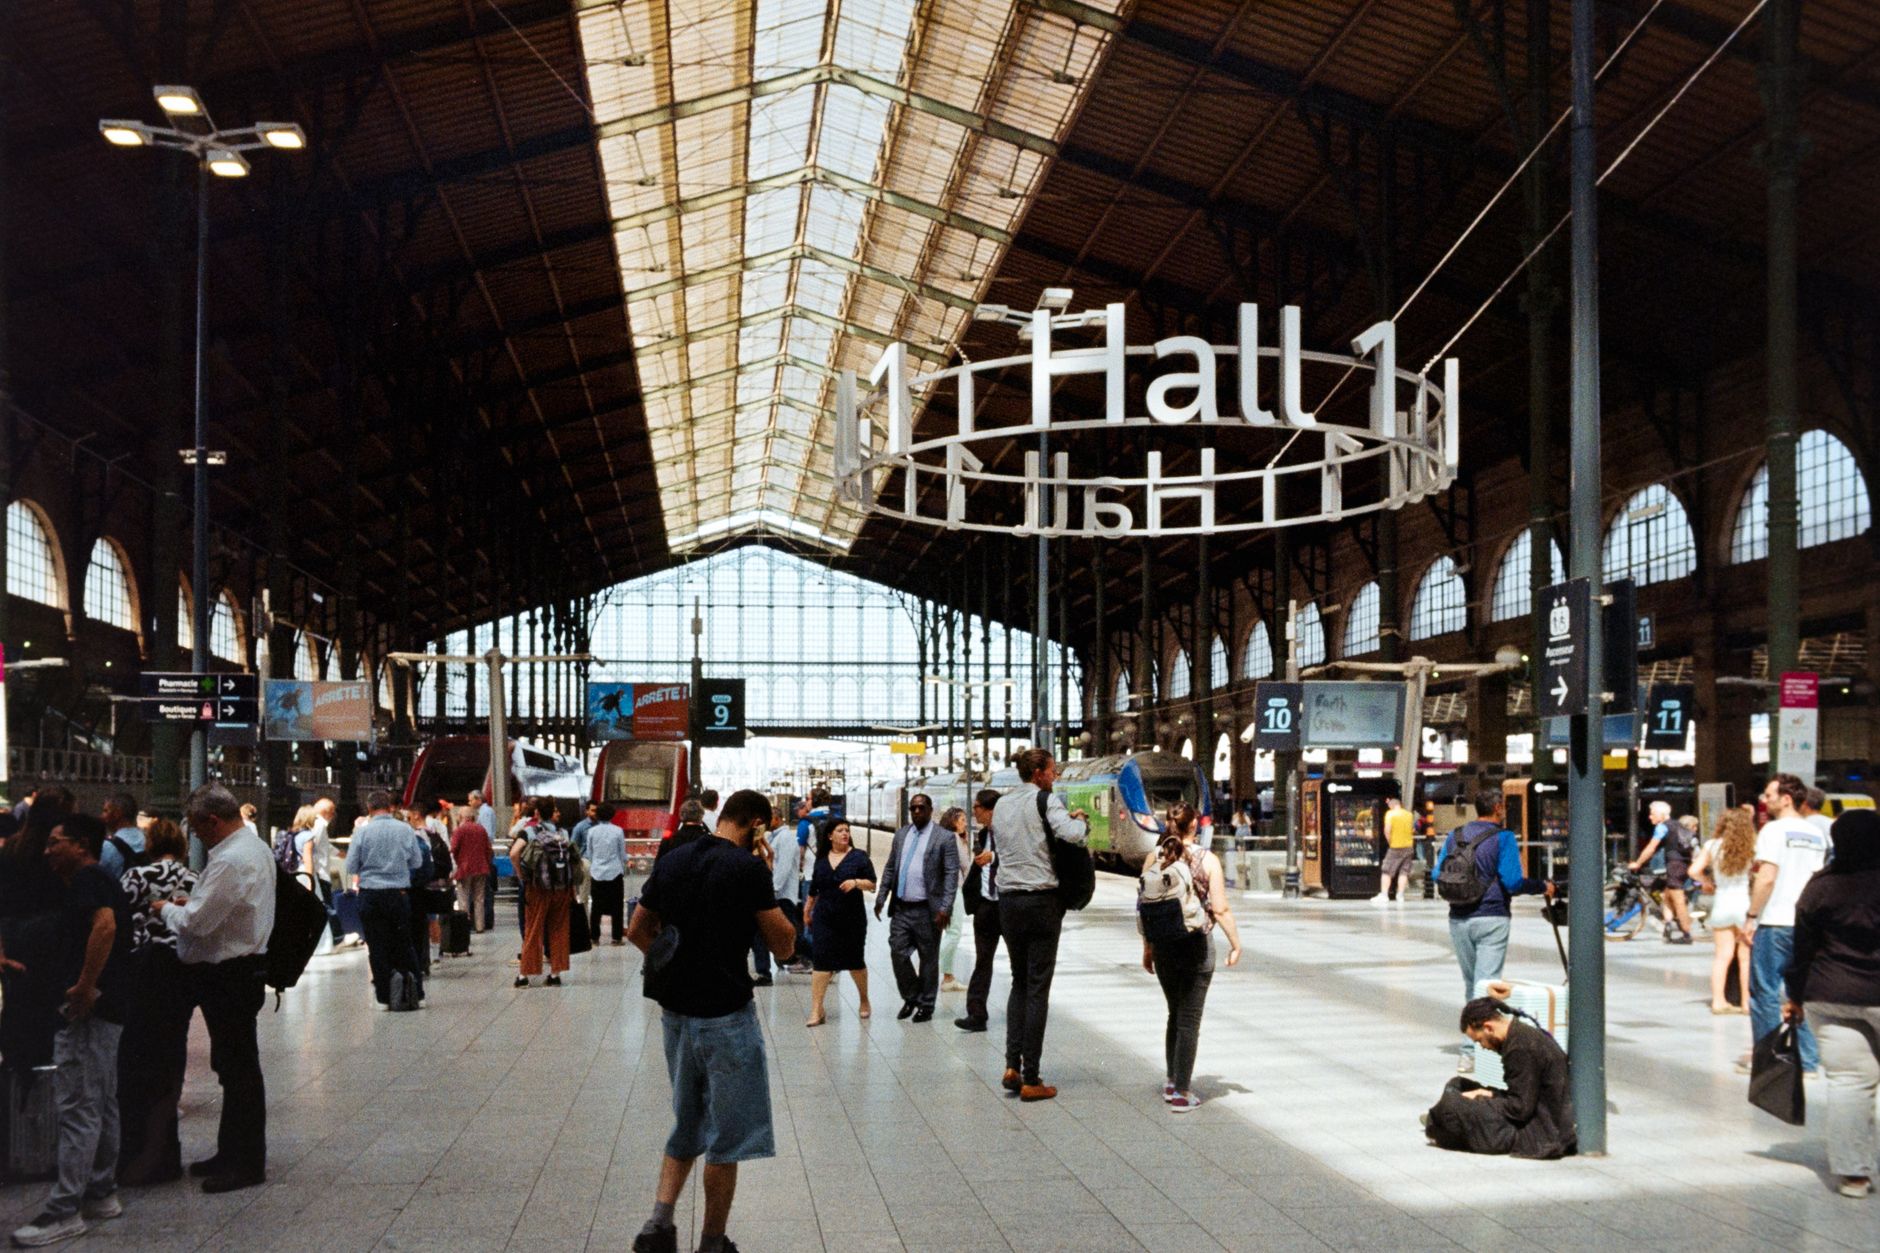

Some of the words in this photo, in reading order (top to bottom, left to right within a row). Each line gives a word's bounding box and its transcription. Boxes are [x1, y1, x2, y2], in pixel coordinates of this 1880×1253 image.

[1031, 302, 1317, 428] Hall
[1350, 320, 1396, 438] 1
[158, 678, 199, 688] Pharmacie
[159, 704, 198, 716] Boutiques
[714, 705, 729, 727] 9
[1263, 708, 1292, 729] 10
[1657, 710, 1683, 731] 11
